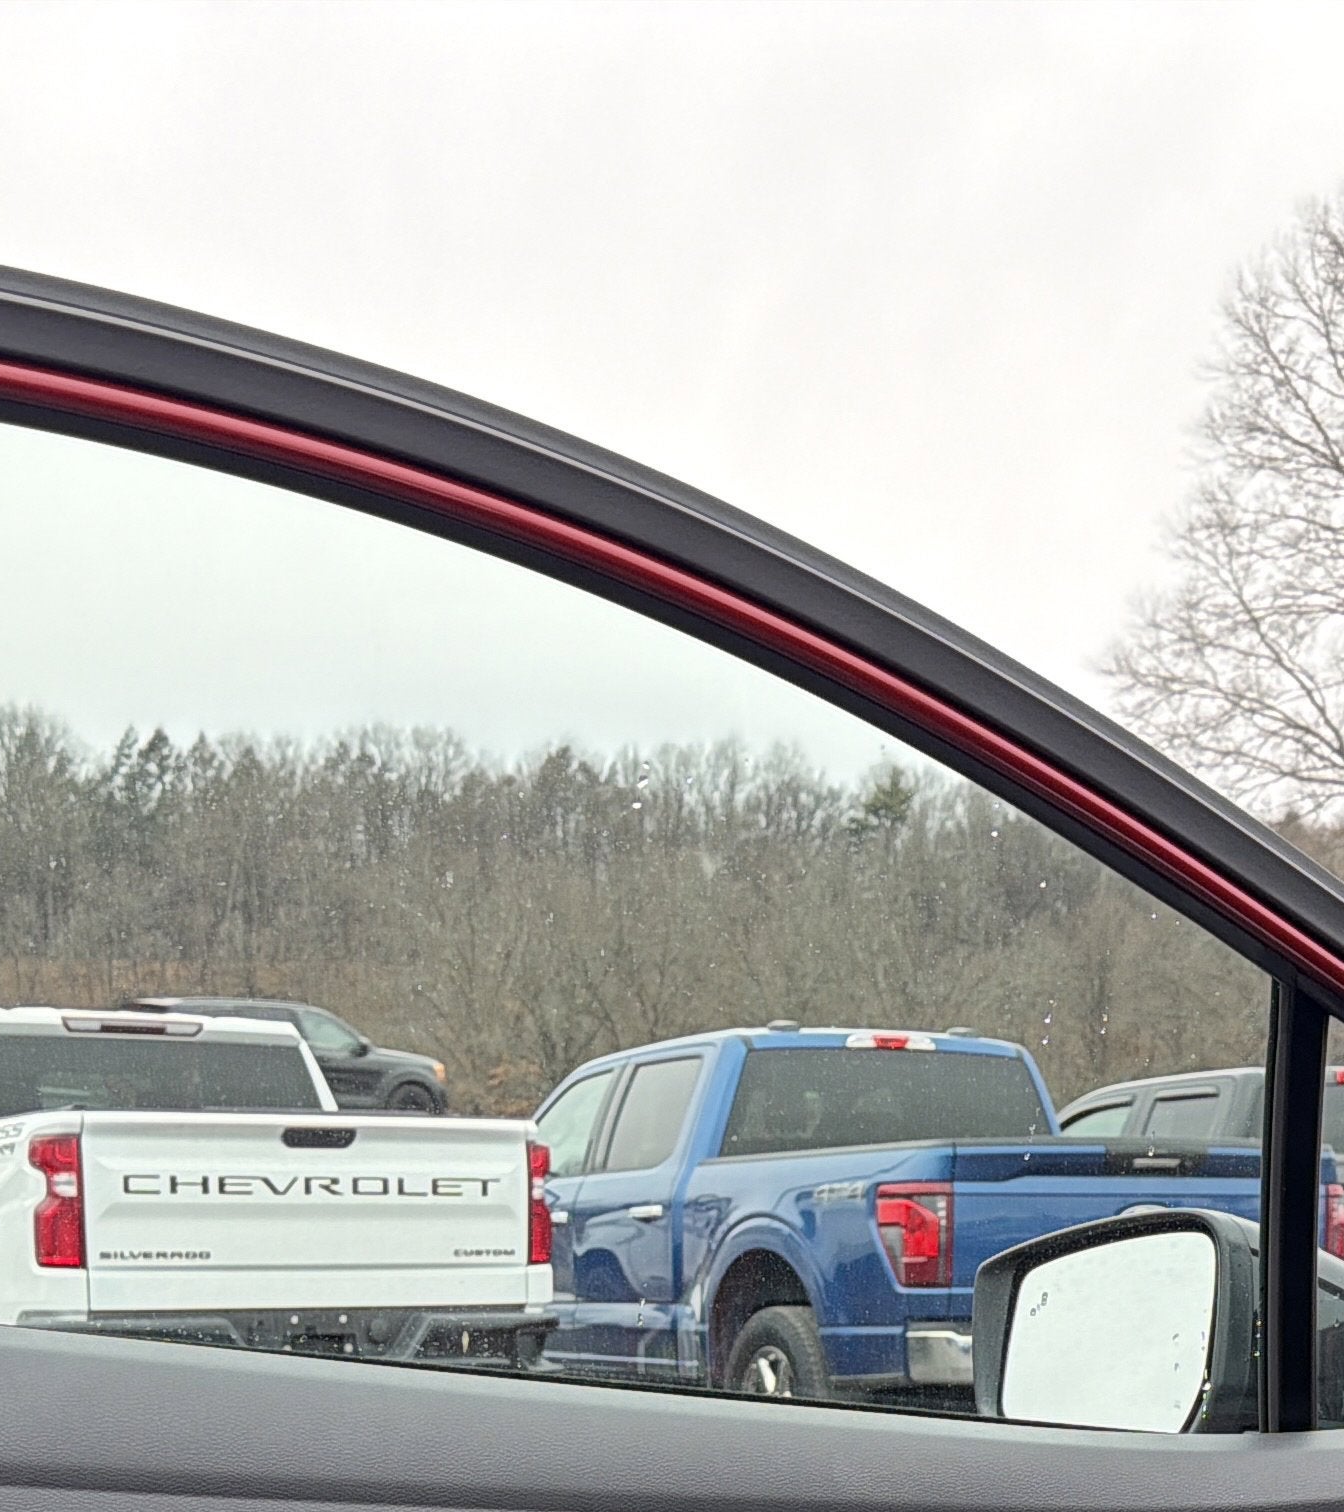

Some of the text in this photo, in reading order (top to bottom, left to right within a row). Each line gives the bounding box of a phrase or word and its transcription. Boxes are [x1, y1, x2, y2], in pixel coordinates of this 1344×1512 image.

[123, 1175, 501, 1197] CHEVROLET
[98, 1249, 212, 1260] SILVERADO
[453, 1247, 517, 1257] CUSTOM
